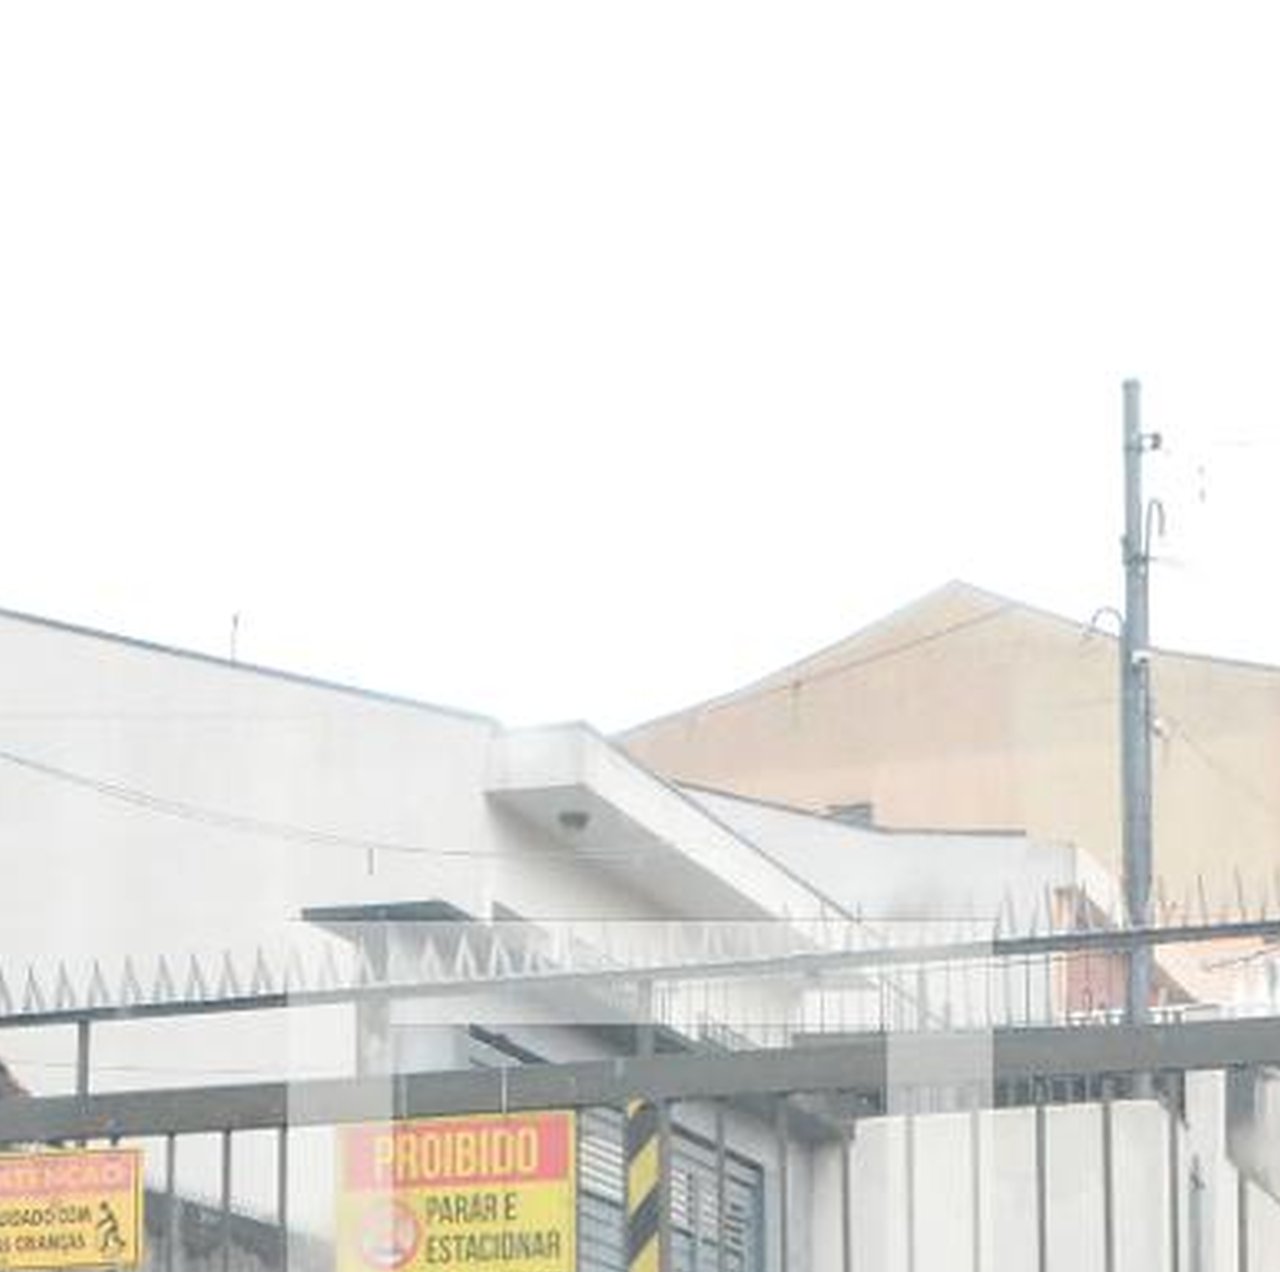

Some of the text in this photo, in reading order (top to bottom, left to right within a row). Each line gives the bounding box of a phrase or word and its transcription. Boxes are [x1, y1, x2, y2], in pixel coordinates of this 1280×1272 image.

[373, 1127, 538, 1181] PROIBIDO
[58, 1205, 93, 1223] COM
[425, 1193, 518, 1224] PARAR E
[15, 1233, 86, 1254] CRIANÇAS
[425, 1230, 561, 1264] ESTACIONAR
